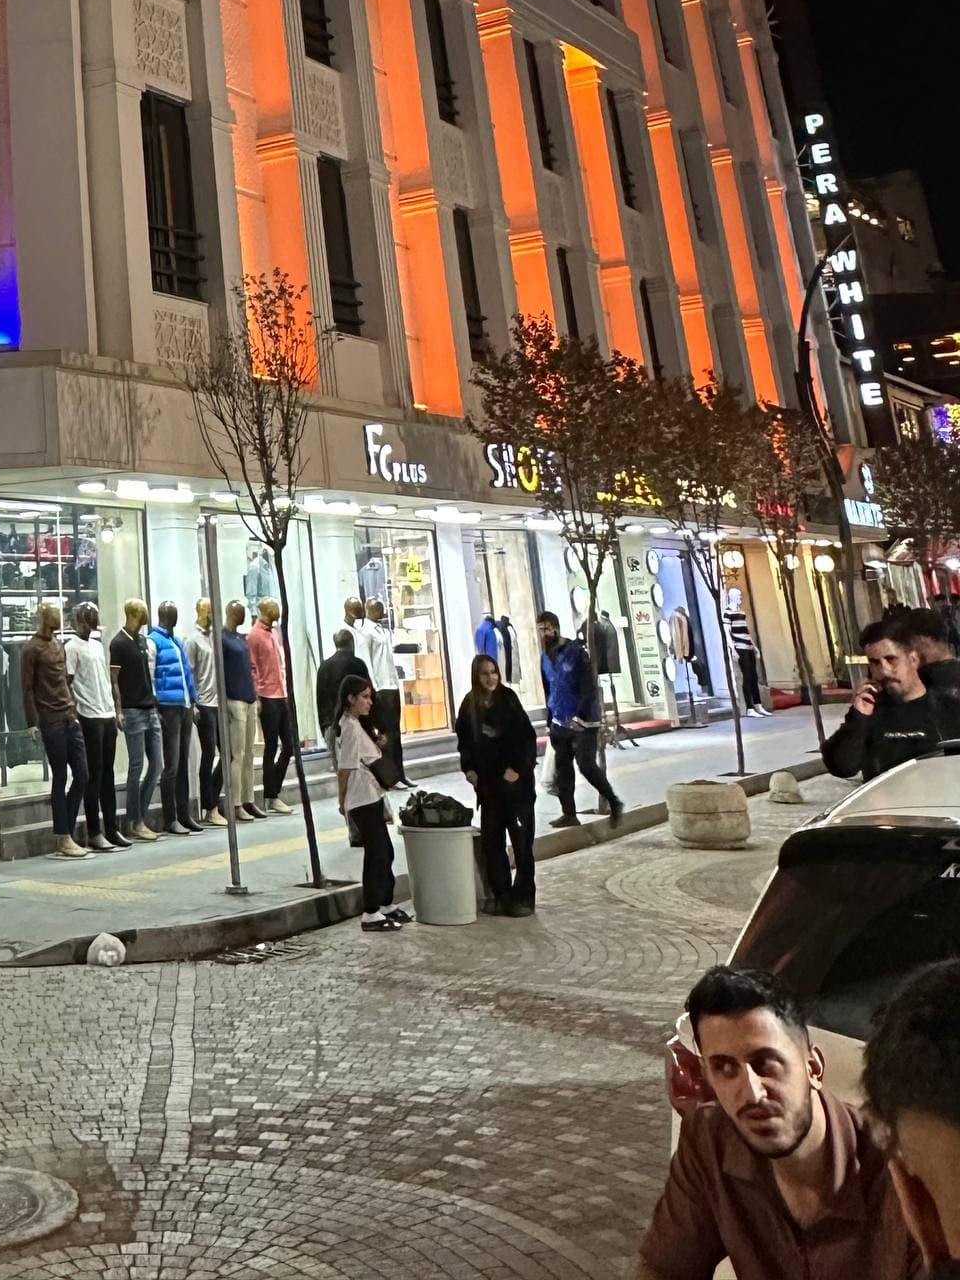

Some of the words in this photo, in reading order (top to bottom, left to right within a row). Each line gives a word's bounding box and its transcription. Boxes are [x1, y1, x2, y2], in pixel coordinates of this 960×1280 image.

[804, 114, 847, 225] PERA
[829, 250, 883, 406] WHITE
[392, 462, 428, 484] PLUS
